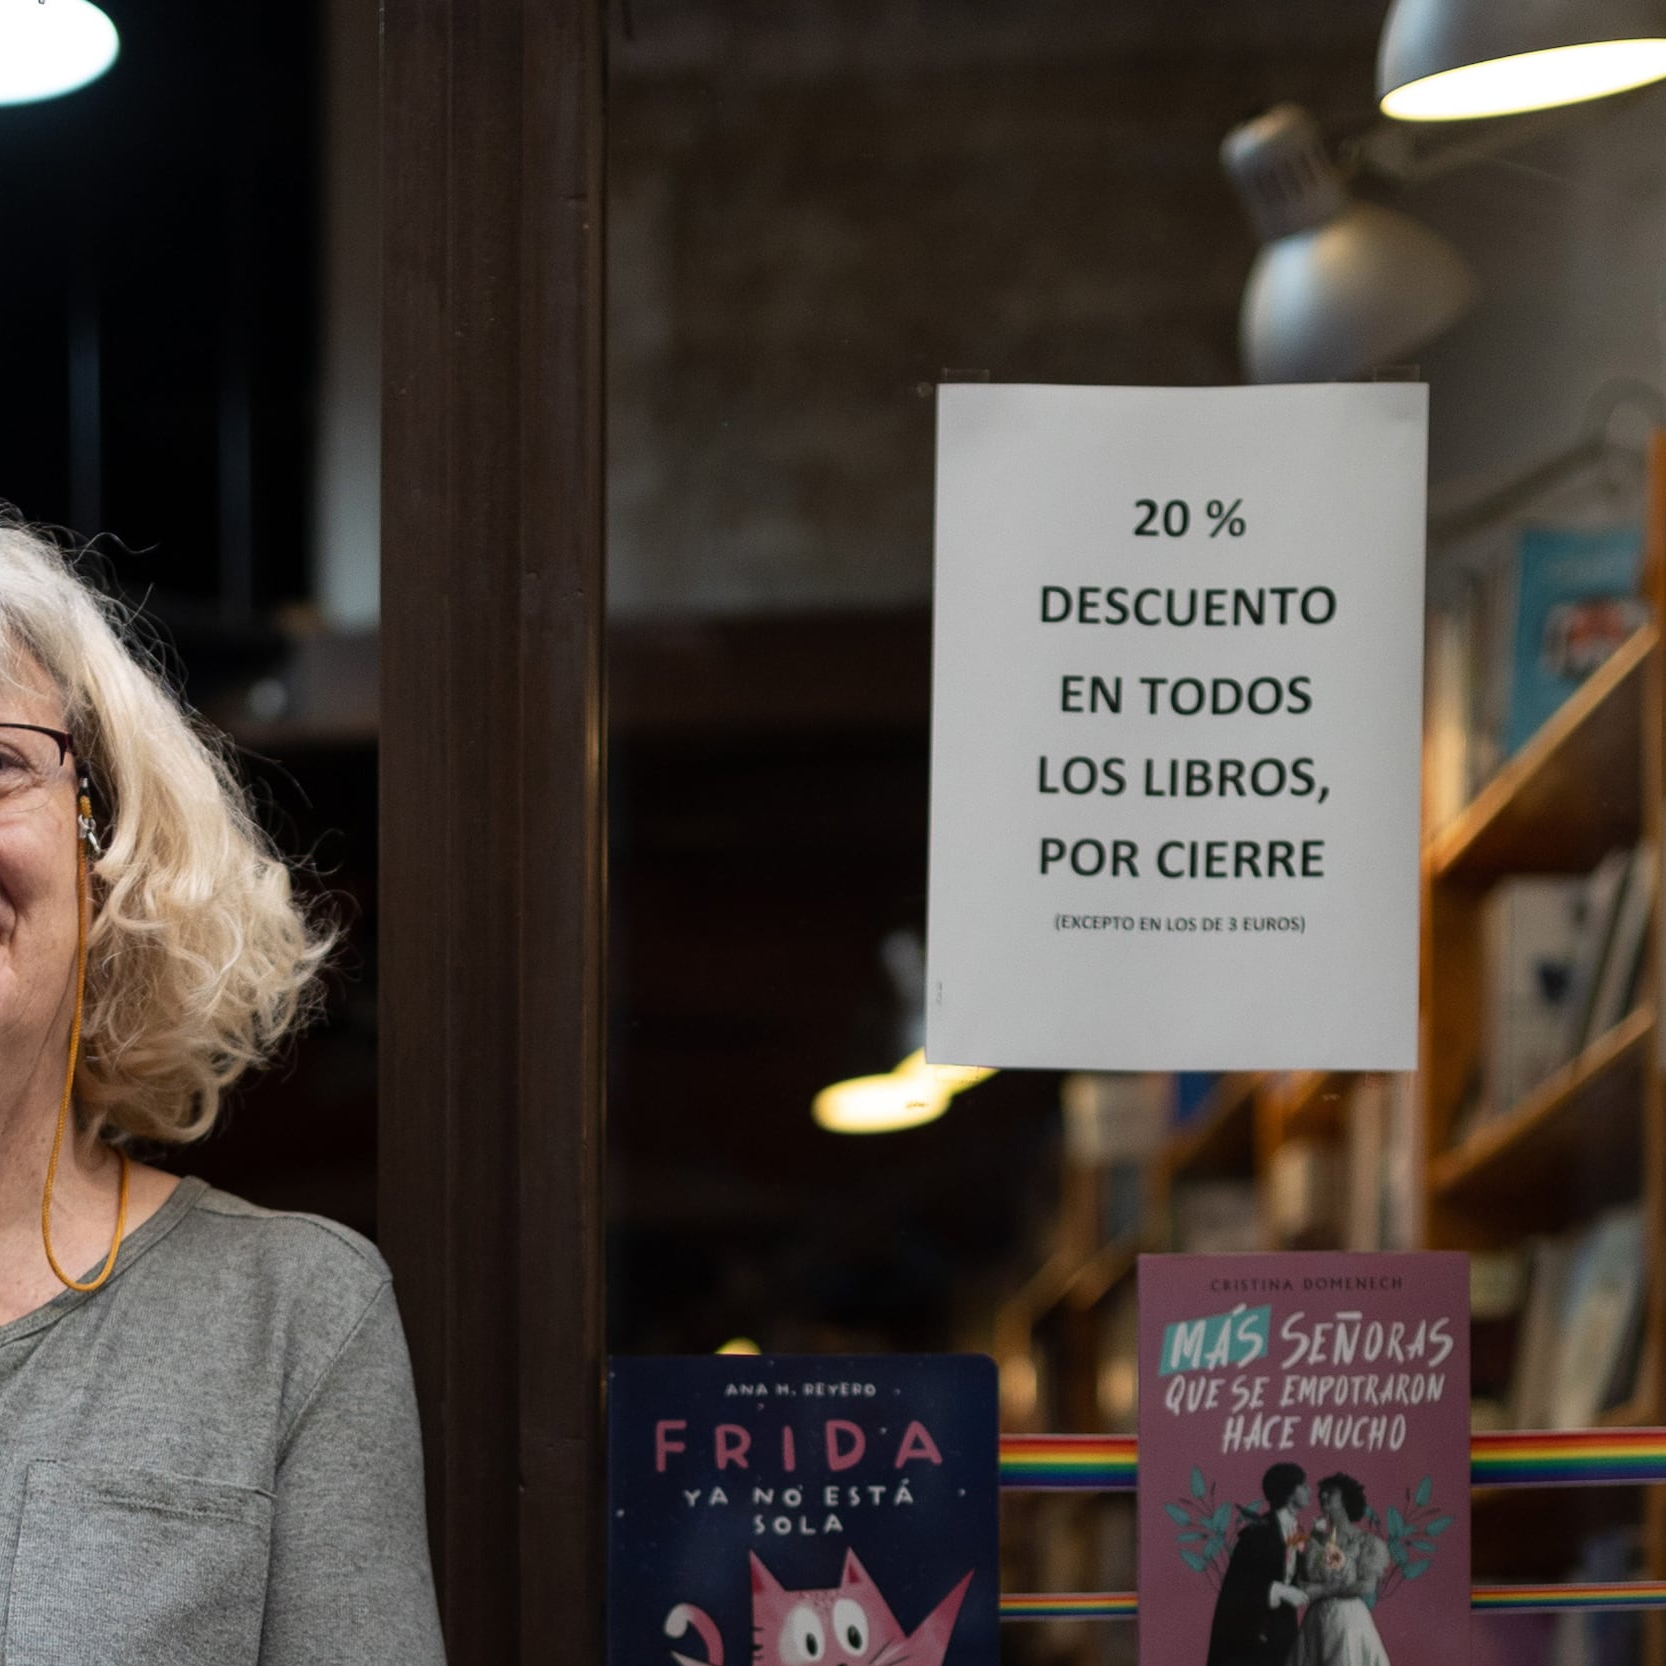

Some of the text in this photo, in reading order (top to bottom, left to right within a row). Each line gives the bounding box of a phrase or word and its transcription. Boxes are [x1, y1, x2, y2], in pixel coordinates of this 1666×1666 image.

[1134, 498, 1246, 539] 20 %
[1041, 585, 1337, 627] DESCUENTO
[1061, 675, 1312, 716] EN TODOS
[1038, 755, 1329, 804] LOS LIBROS,
[1040, 837, 1324, 879] POR CIERRE
[1055, 914, 1306, 934] (EXCEPTO EN LOS DE 3 EUROS)
[1211, 1277, 1402, 1291] CRISTINA DOMENECH
[1168, 1303, 1455, 1371] MÁS SEÑORAS
[725, 1382, 877, 1398] ANA H. REYERO
[1165, 1373, 1446, 1415] QUE SE EMPOTRARON
[655, 1419, 943, 1472] FRIDA
[1222, 1412, 1407, 1455] HACE MUCHO
[683, 1478, 914, 1507] YA NO ESTÁ
[752, 1513, 844, 1535] SOLA
